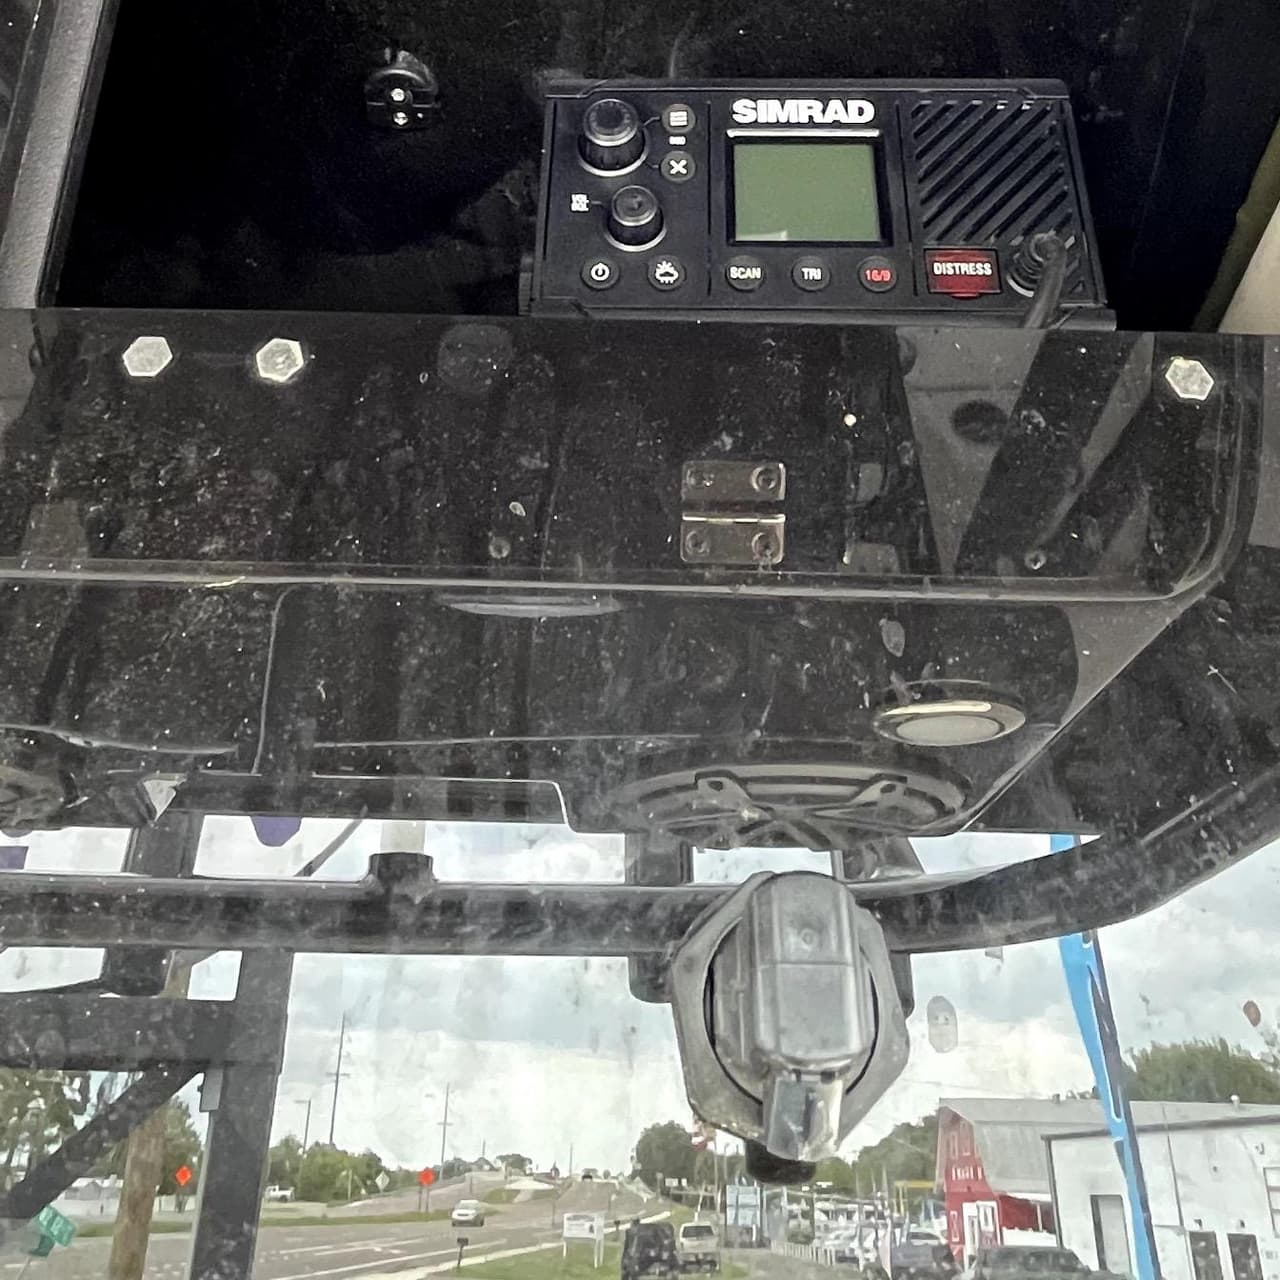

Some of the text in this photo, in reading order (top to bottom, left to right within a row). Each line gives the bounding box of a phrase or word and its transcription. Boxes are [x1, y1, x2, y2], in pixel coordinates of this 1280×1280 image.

[732, 98, 875, 124] SIMRAD
[729, 266, 762, 280] SCAN
[801, 267, 822, 281] TRI
[933, 262, 992, 276] DISTRESS
